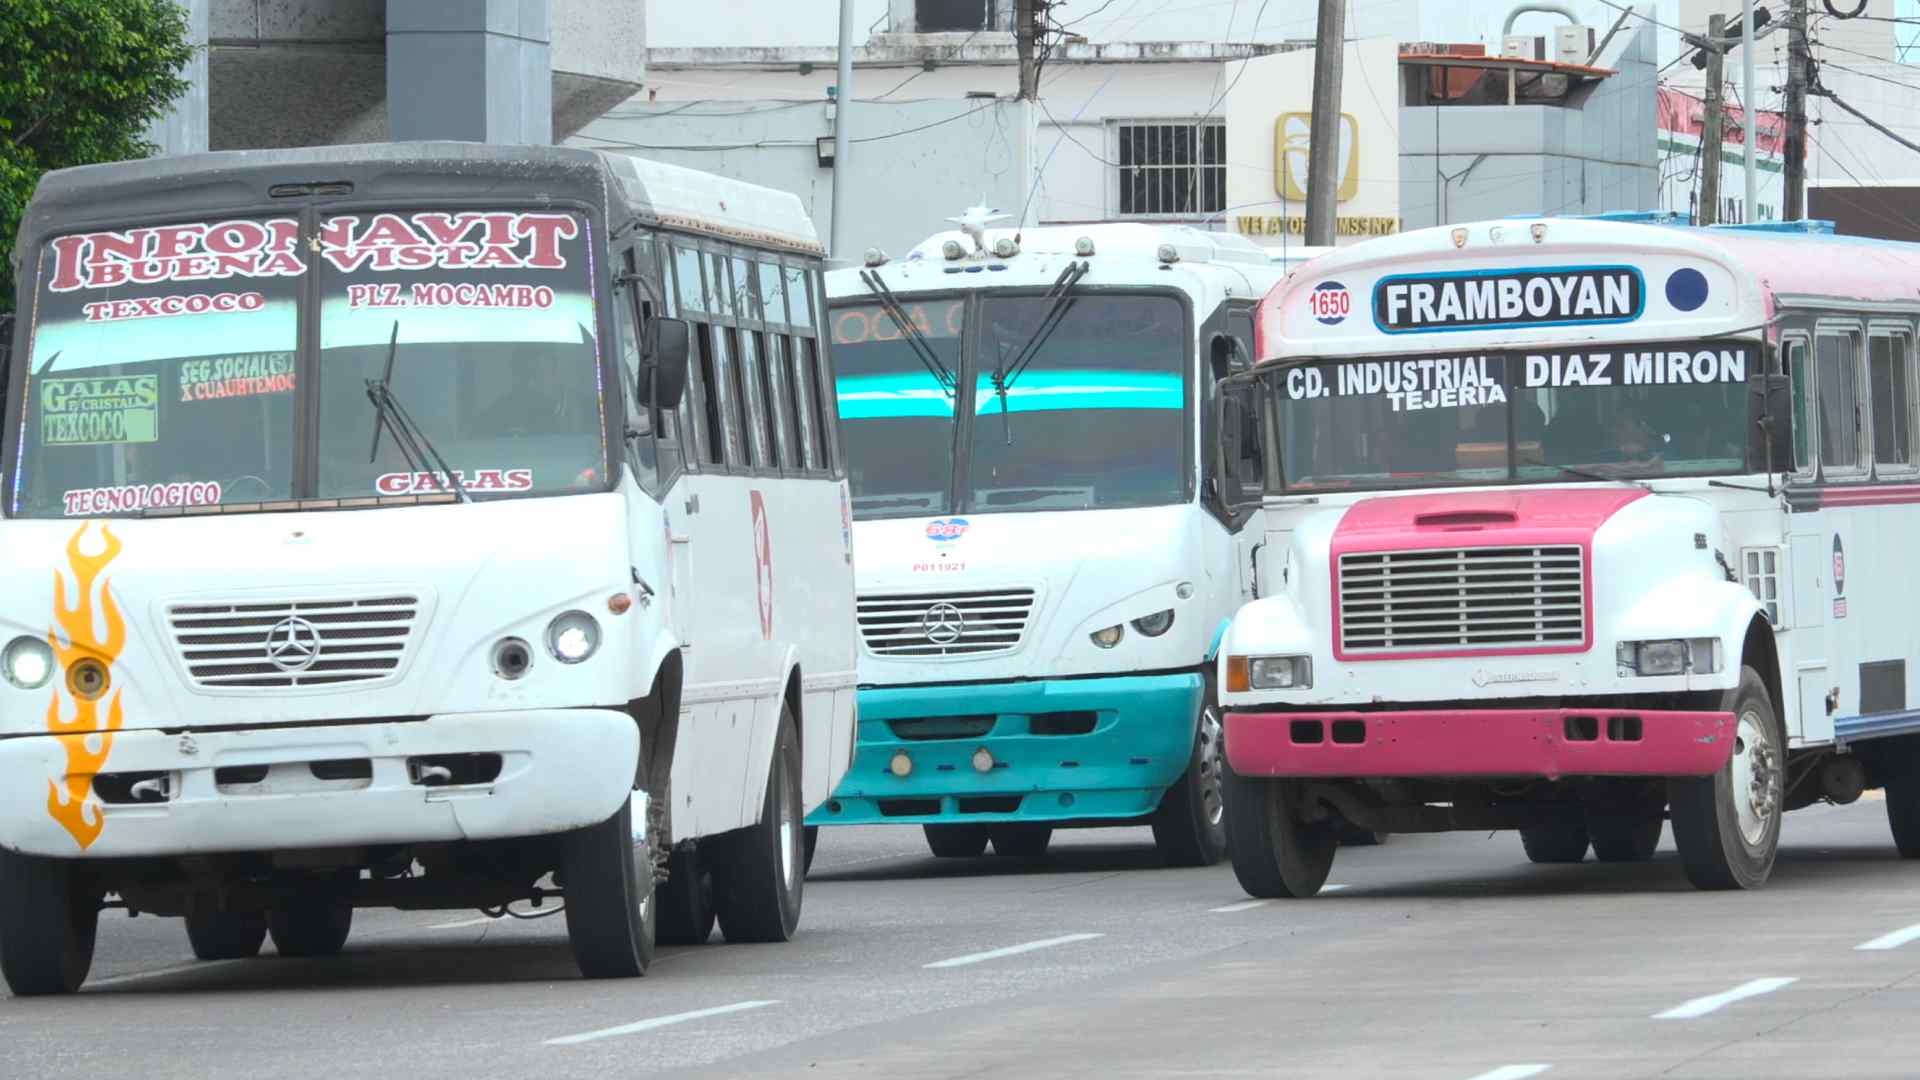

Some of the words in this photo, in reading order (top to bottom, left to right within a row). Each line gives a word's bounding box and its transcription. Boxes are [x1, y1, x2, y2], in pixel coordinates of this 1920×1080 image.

[85, 251, 307, 289] BUENA
[322, 244, 526, 272] VISTA
[83, 292, 265, 321] TEXCOCO
[348, 284, 408, 309] PLZ.
[412, 282, 554, 310] MOCAMBO
[1309, 290, 1350, 316] 1650
[1386, 274, 1631, 325] FRAMBOYAN
[1287, 366, 1330, 400] CD.
[1337, 356, 1495, 396] INDUSTRIAL
[1525, 353, 1613, 388] DIAZ
[1623, 350, 1746, 385] MIRON
[44, 378, 158, 413] GALAS
[194, 373, 296, 400] CUAUHTEMOC
[1386, 384, 1508, 411] TEJERIA
[64, 480, 222, 515] TECNOLOGICO
[376, 469, 533, 495] GALAS
